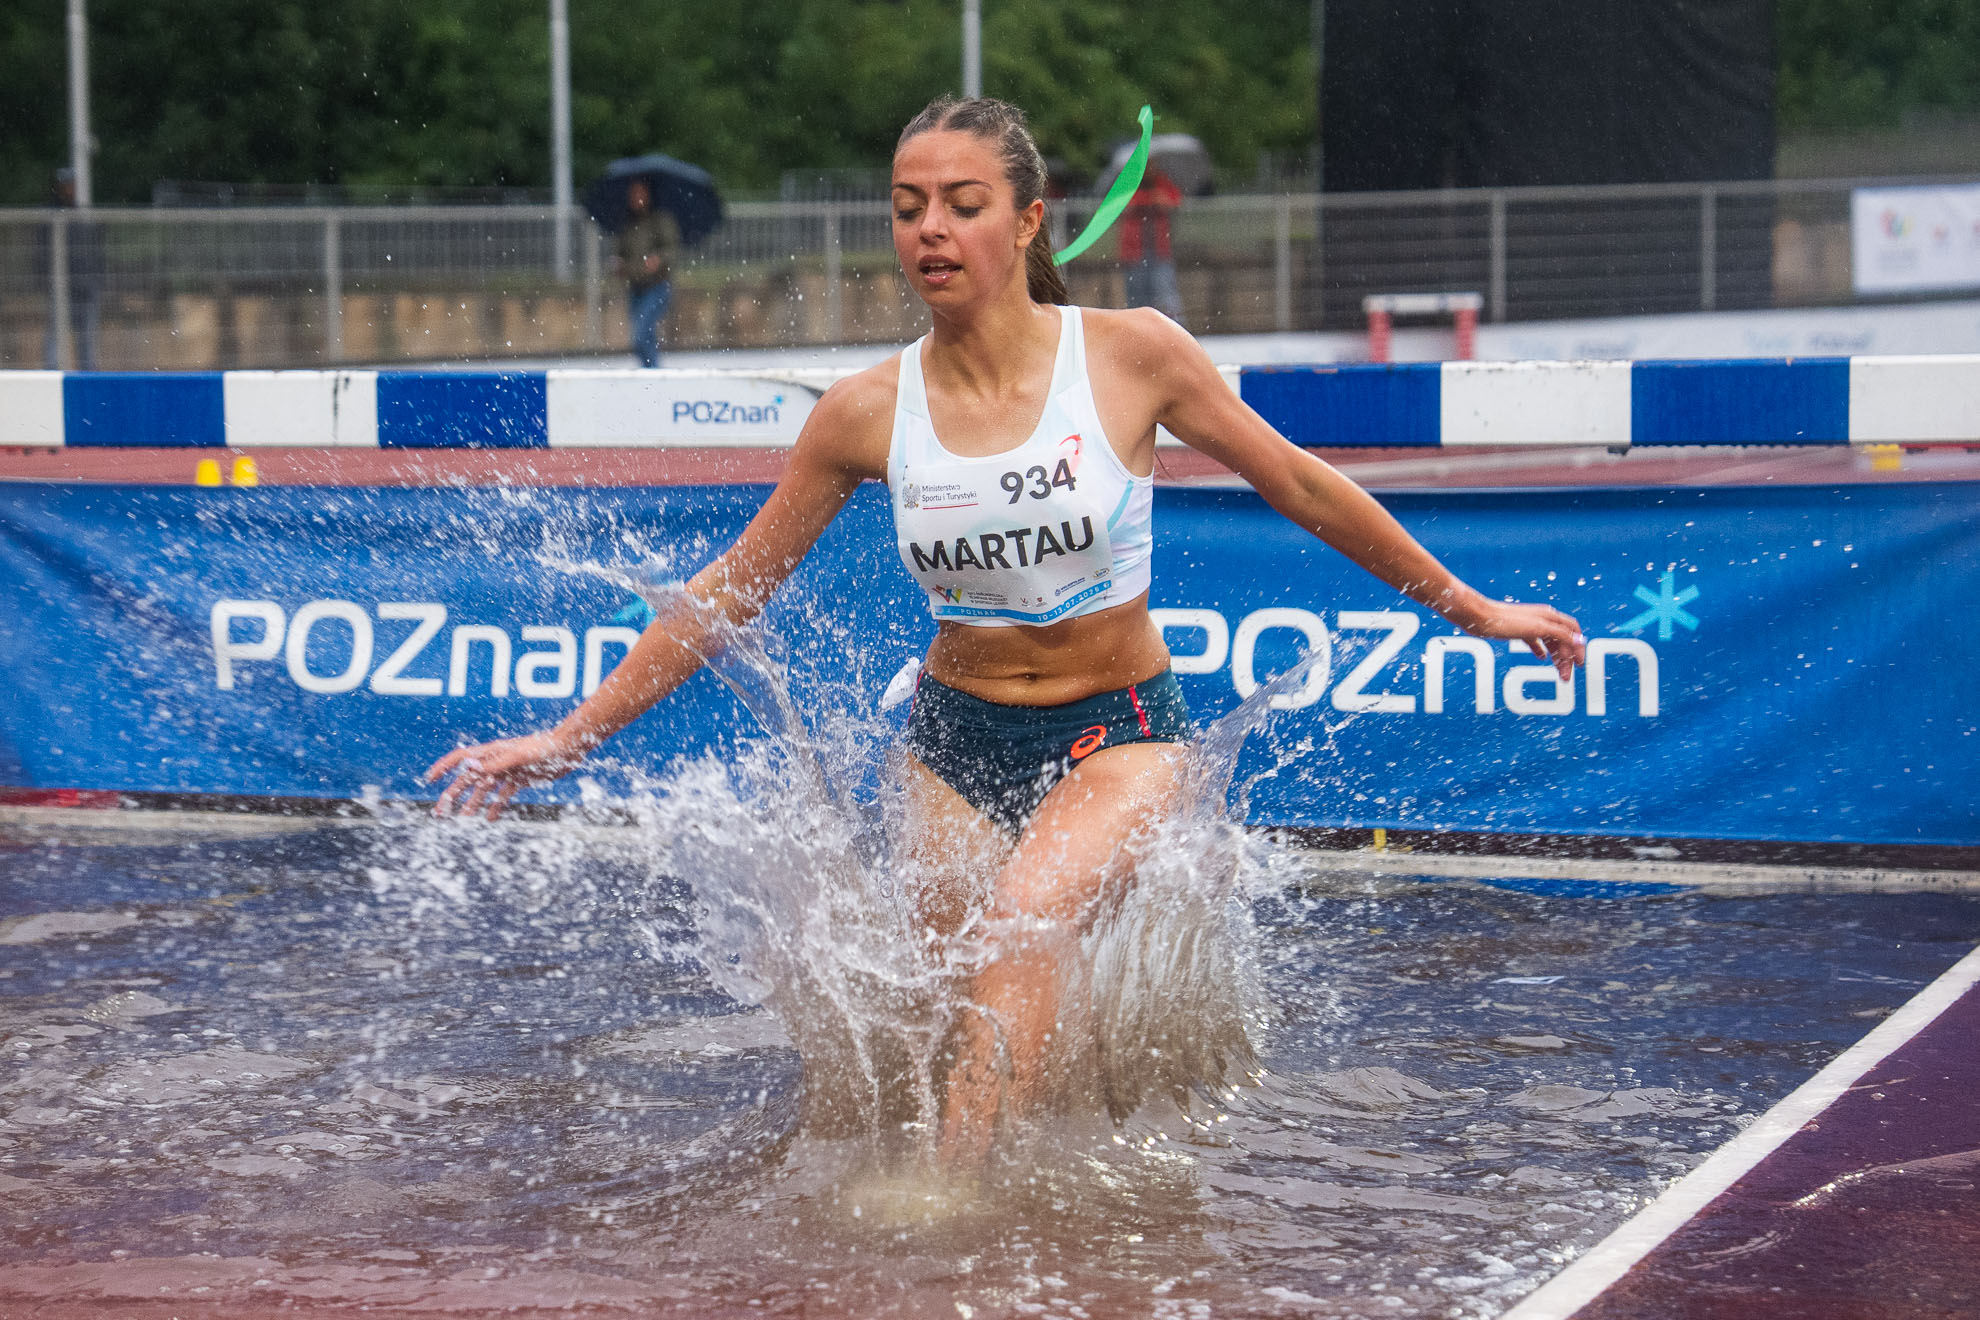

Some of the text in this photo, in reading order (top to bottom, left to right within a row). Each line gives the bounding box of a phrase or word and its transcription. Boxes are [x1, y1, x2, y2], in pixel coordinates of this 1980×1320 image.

[921, 484, 961, 493] Ministerstwo
[1000, 458, 1076, 505] 934
[921, 494, 942, 503] Sportu
[947, 491, 977, 501] Turystyki
[909, 516, 1095, 572] MARTAU
